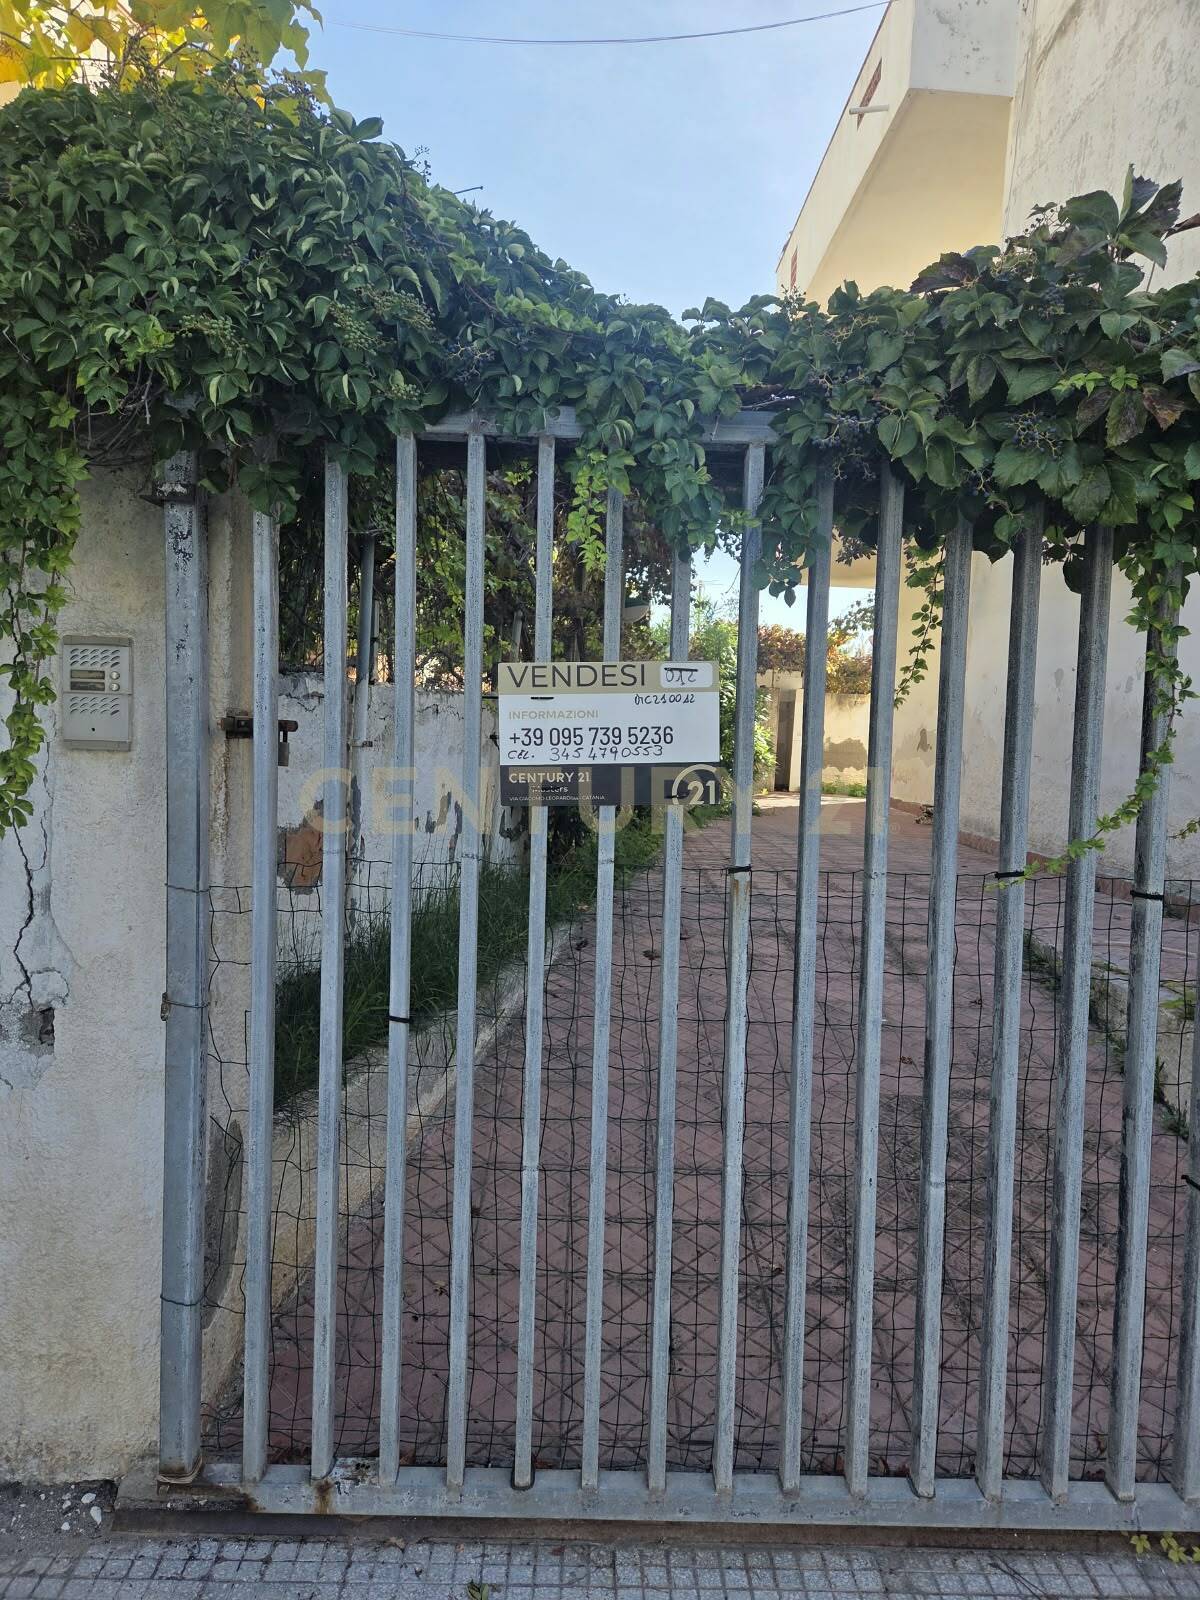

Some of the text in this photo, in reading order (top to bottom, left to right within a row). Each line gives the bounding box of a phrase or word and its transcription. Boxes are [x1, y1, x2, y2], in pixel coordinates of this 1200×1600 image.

[507, 663, 645, 688] VENDESI
[508, 709, 599, 721] INFORMAZIONI
[509, 725, 674, 747] +39 095 739 5236
[508, 771, 590, 784] CENTURY 21
